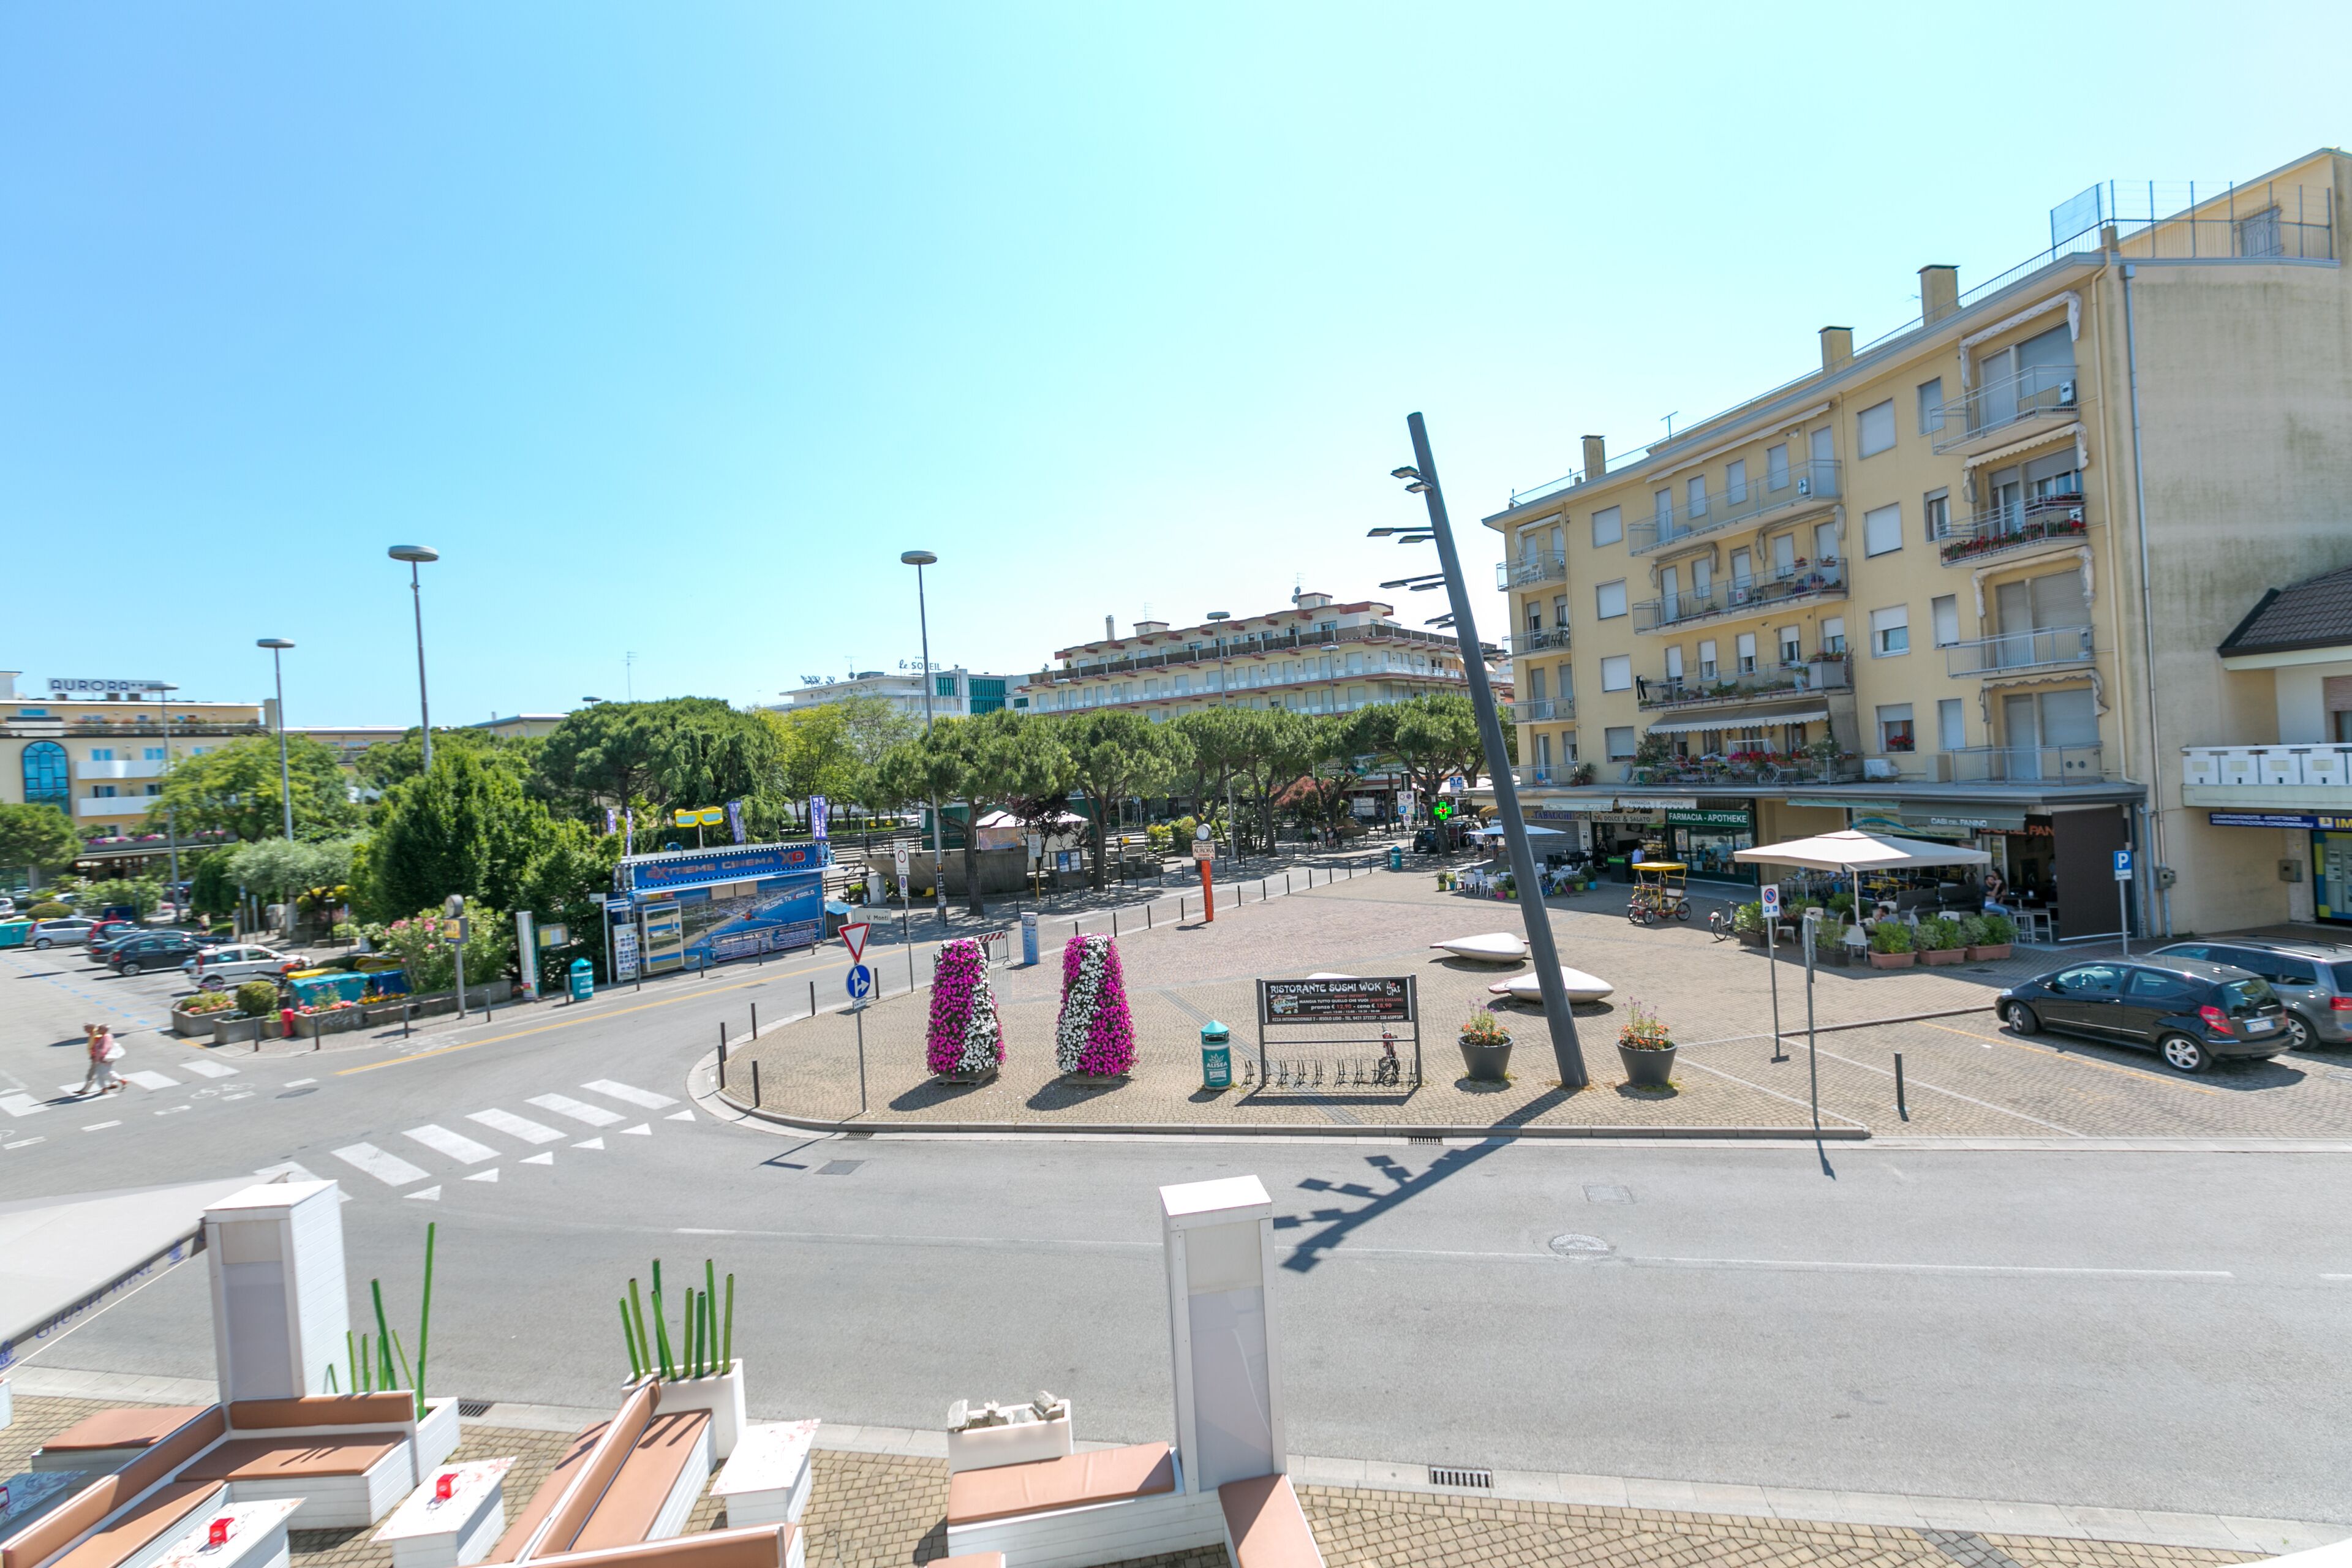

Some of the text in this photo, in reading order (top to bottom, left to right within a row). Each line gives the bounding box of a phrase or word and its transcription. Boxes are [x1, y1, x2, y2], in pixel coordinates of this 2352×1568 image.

[911, 662, 942, 671] SOEIL
[50, 679, 129, 691] AURORA
[1668, 812, 1703, 821] FARMACIA
[1708, 814, 1747, 823] APOTHEKE
[721, 856, 775, 870] CINEMA
[778, 850, 806, 865] XD
[2118, 853, 2129, 869] P
[762, 899, 784, 912] WELCOME
[1270, 982, 1382, 994] RISTORANTE SUSHI WOK
